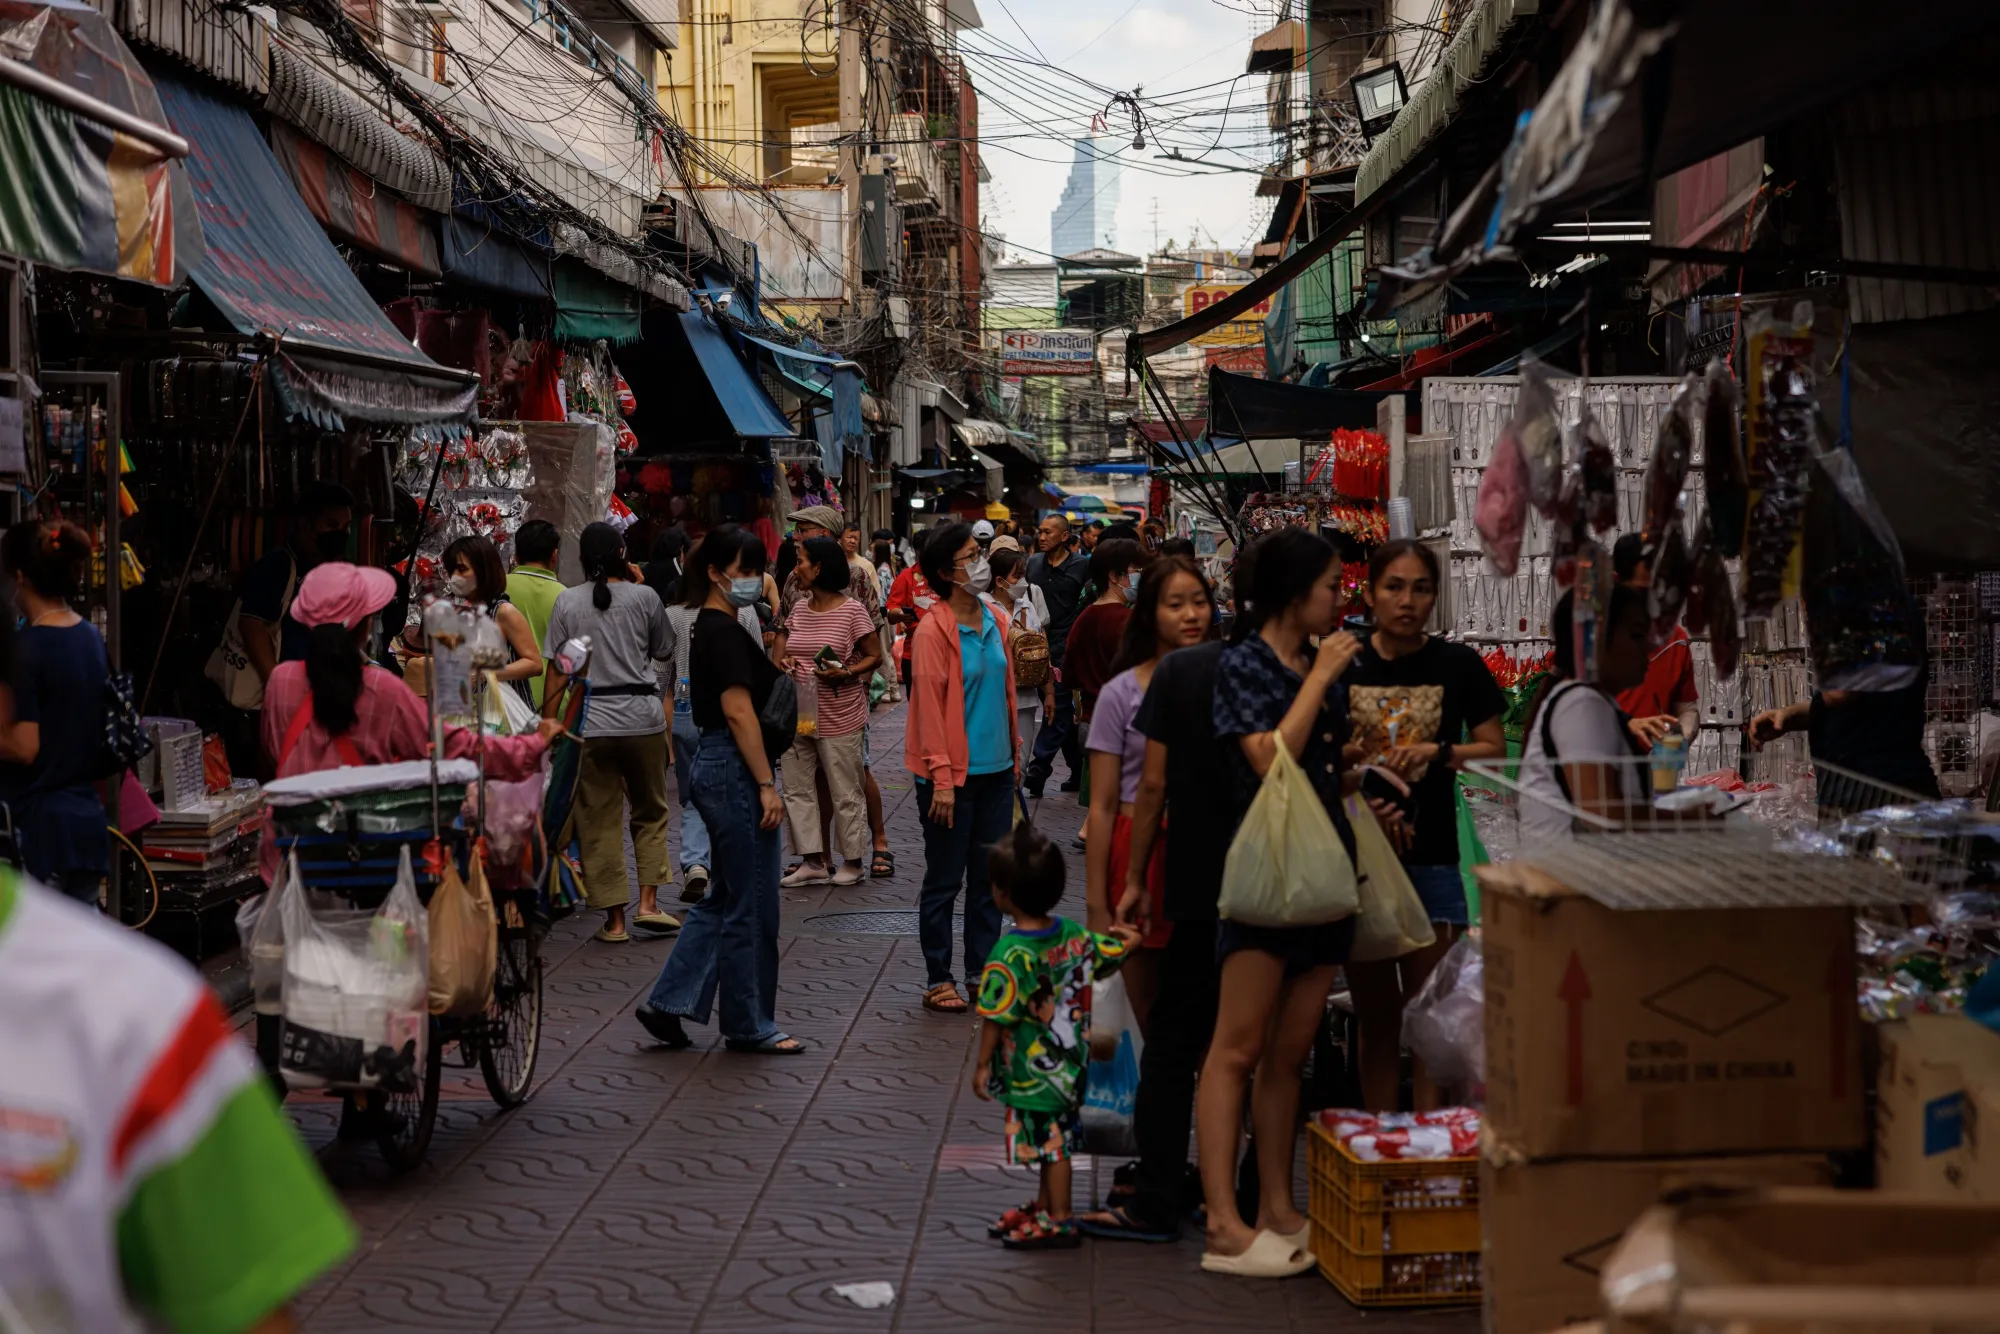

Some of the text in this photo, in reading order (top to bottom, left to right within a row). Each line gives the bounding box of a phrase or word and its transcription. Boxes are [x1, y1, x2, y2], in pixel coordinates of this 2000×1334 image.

[1057, 351, 1071, 360] TOY
[1073, 351, 1093, 360] SHOP
[1627, 1060, 1796, 1082] MADE IN CHINA
